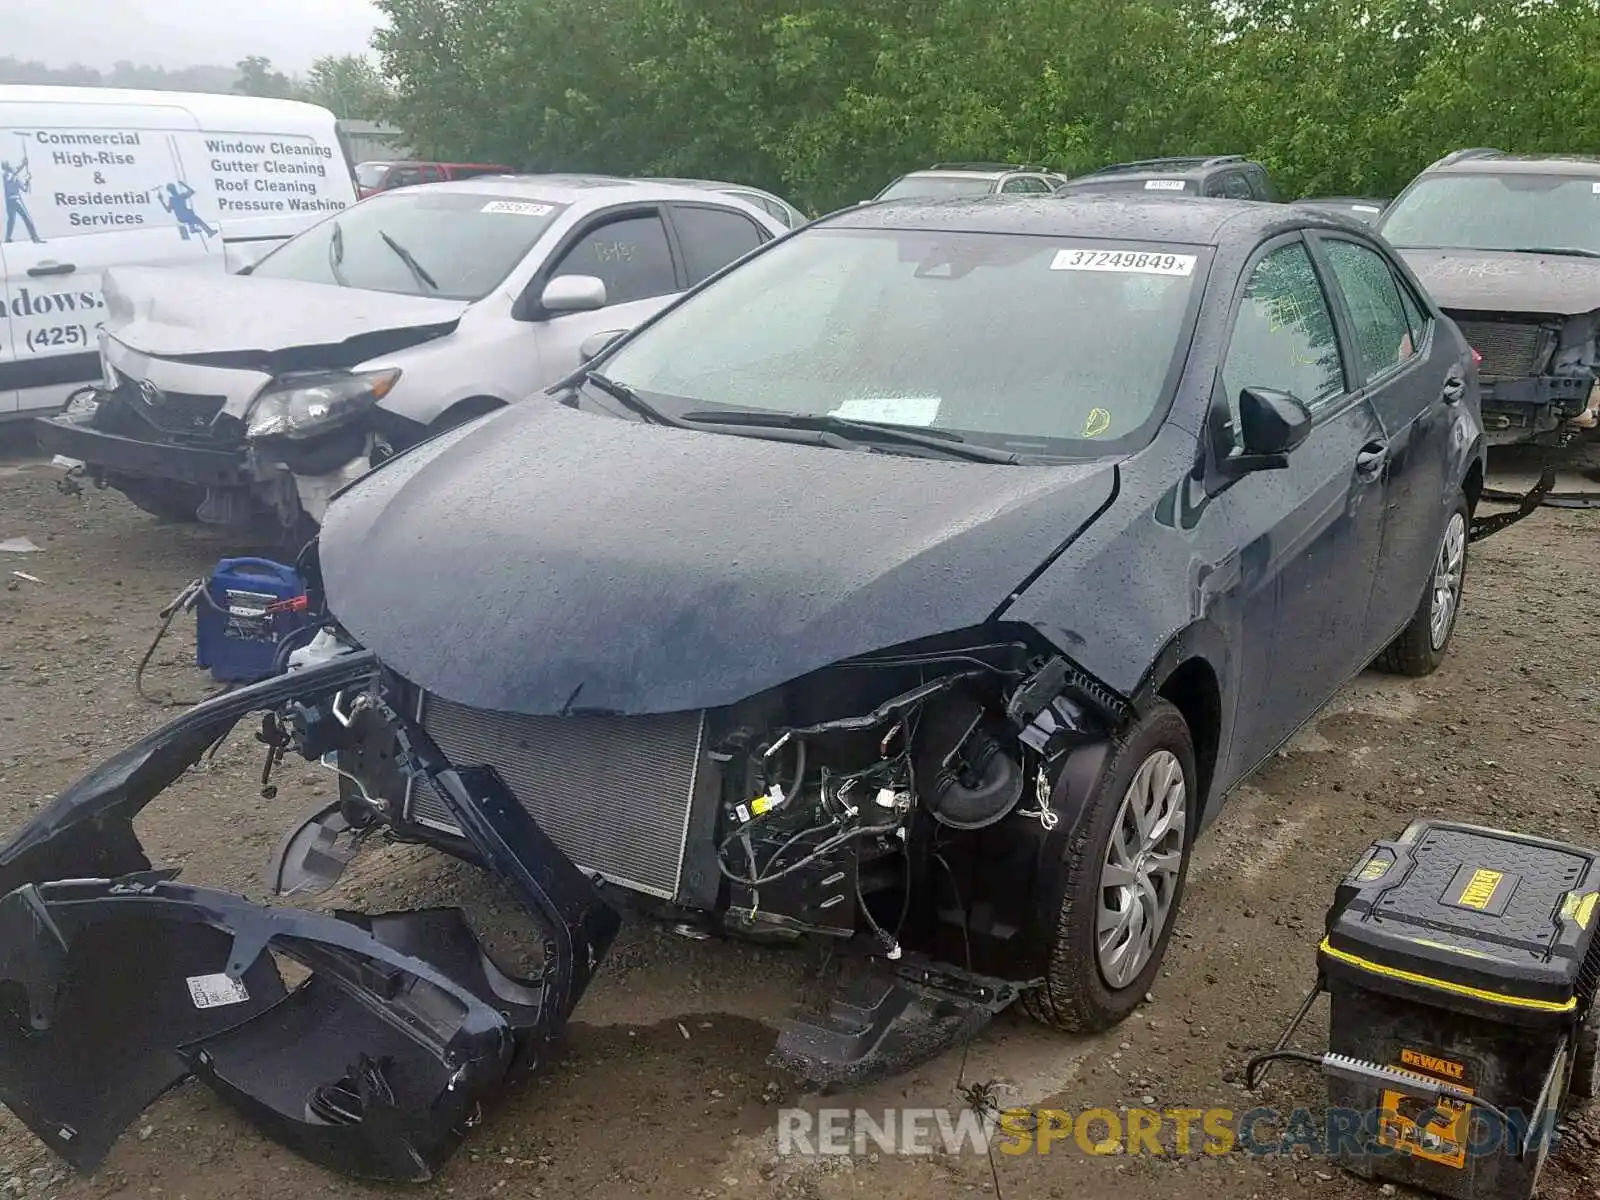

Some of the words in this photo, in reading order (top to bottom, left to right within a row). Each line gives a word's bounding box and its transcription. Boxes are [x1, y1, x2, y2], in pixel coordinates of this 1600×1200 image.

[36, 131, 141, 145] Commercial
[205, 140, 266, 154] Window
[270, 142, 332, 158] Cleaning
[52, 151, 136, 167] High-Rise
[210, 159, 259, 173] Gutter
[263, 161, 326, 177] Cleaning
[93, 171, 106, 185] &
[214, 178, 249, 191] Roof
[254, 179, 317, 195] Cleaning
[54, 191, 151, 206] Residential
[218, 198, 285, 211] Pressure
[69, 212, 144, 226] Services
[26, 323, 88, 353] (425)
